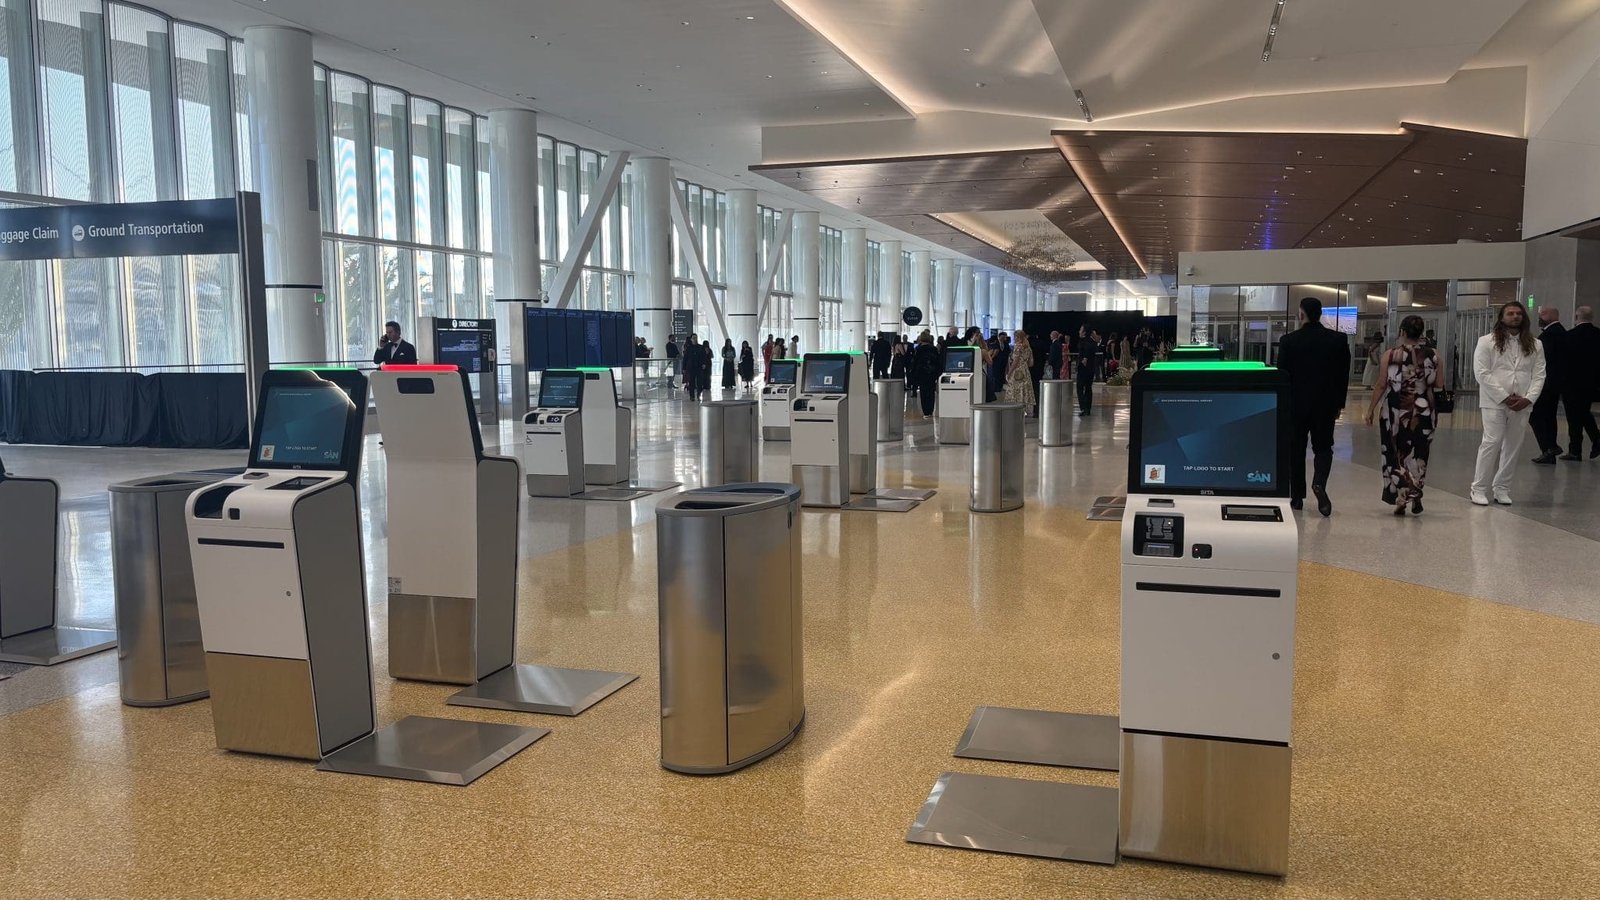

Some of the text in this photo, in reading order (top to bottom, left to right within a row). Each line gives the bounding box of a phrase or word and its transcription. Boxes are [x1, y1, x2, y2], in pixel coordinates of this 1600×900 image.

[0, 226, 59, 244] ggage Claim
[88, 221, 204, 238] Ground Transportation
[324, 450, 339, 459] SAN
[1247, 470, 1271, 483] SAN
